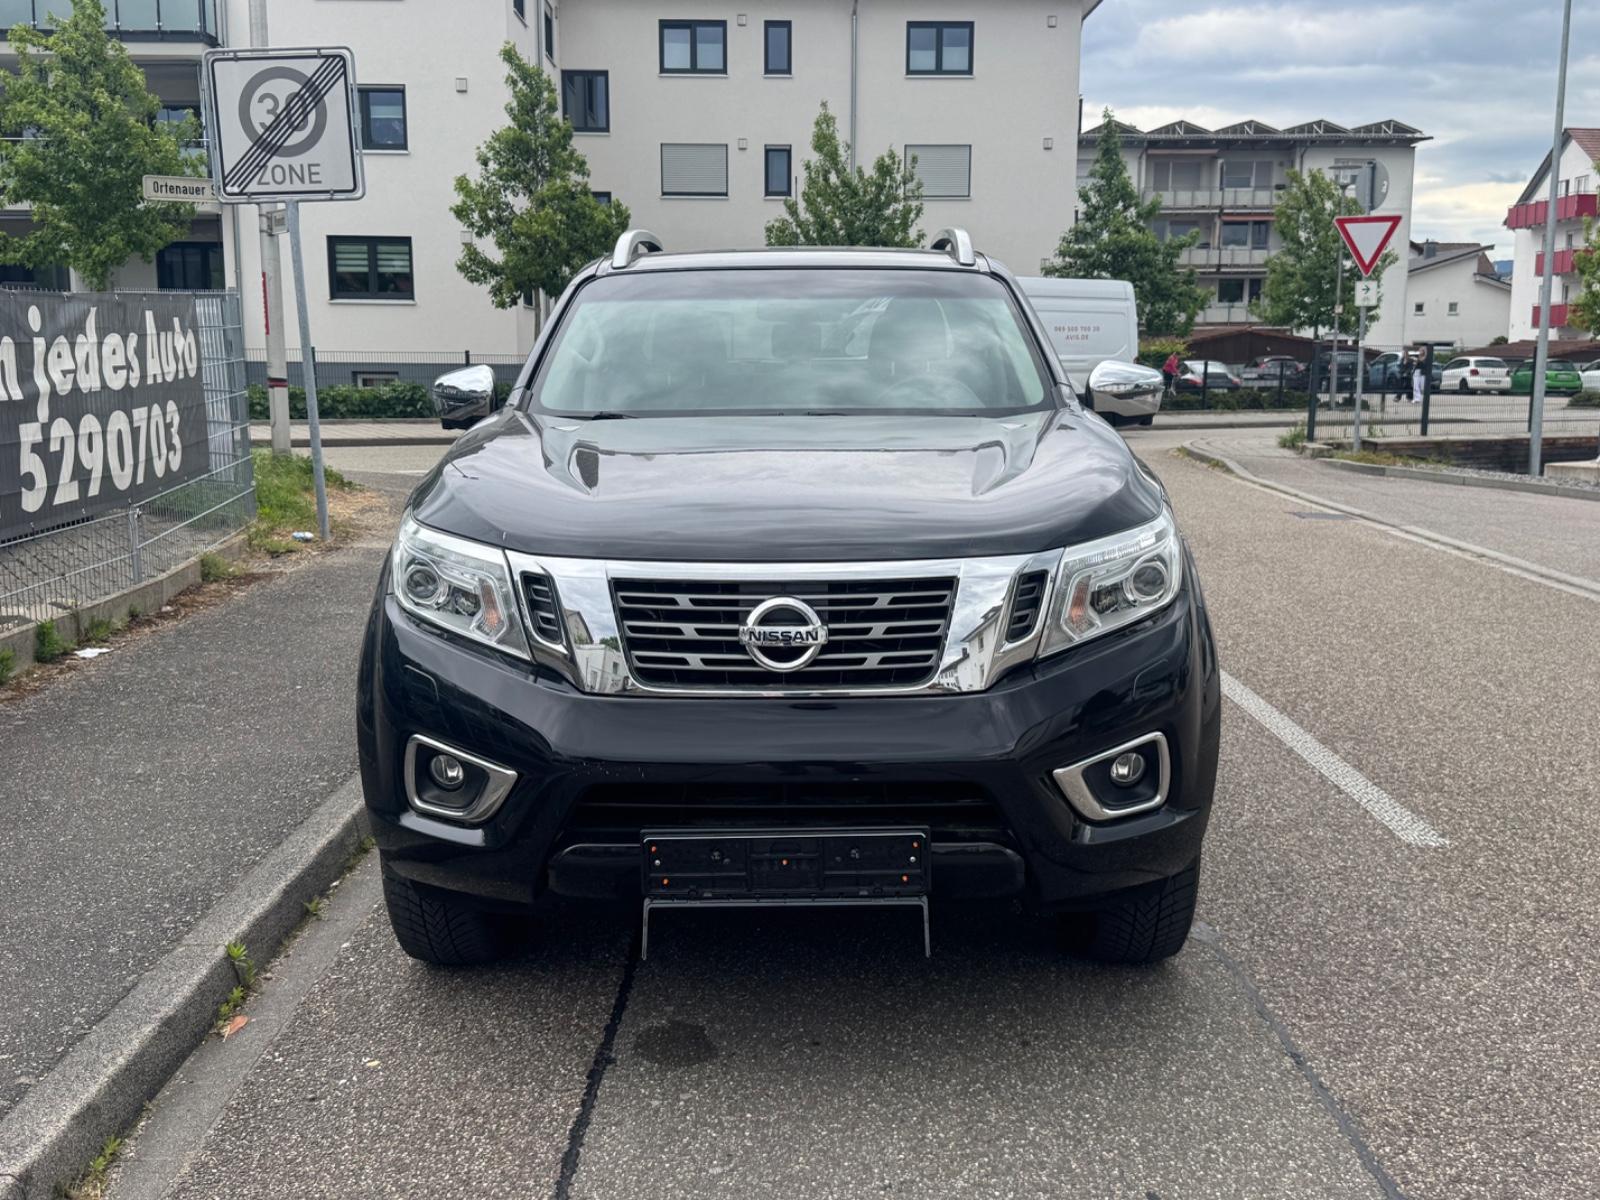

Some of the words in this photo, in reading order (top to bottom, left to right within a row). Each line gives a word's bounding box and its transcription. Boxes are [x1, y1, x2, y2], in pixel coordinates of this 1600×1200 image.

[257, 91, 309, 132] 30
[152, 180, 206, 196] Ortenauer
[256, 163, 322, 186] ZONE
[27, 304, 140, 424] jedes
[145, 309, 198, 385] Auto
[18, 399, 183, 513] 5290703
[749, 630, 819, 642] NISSAN
